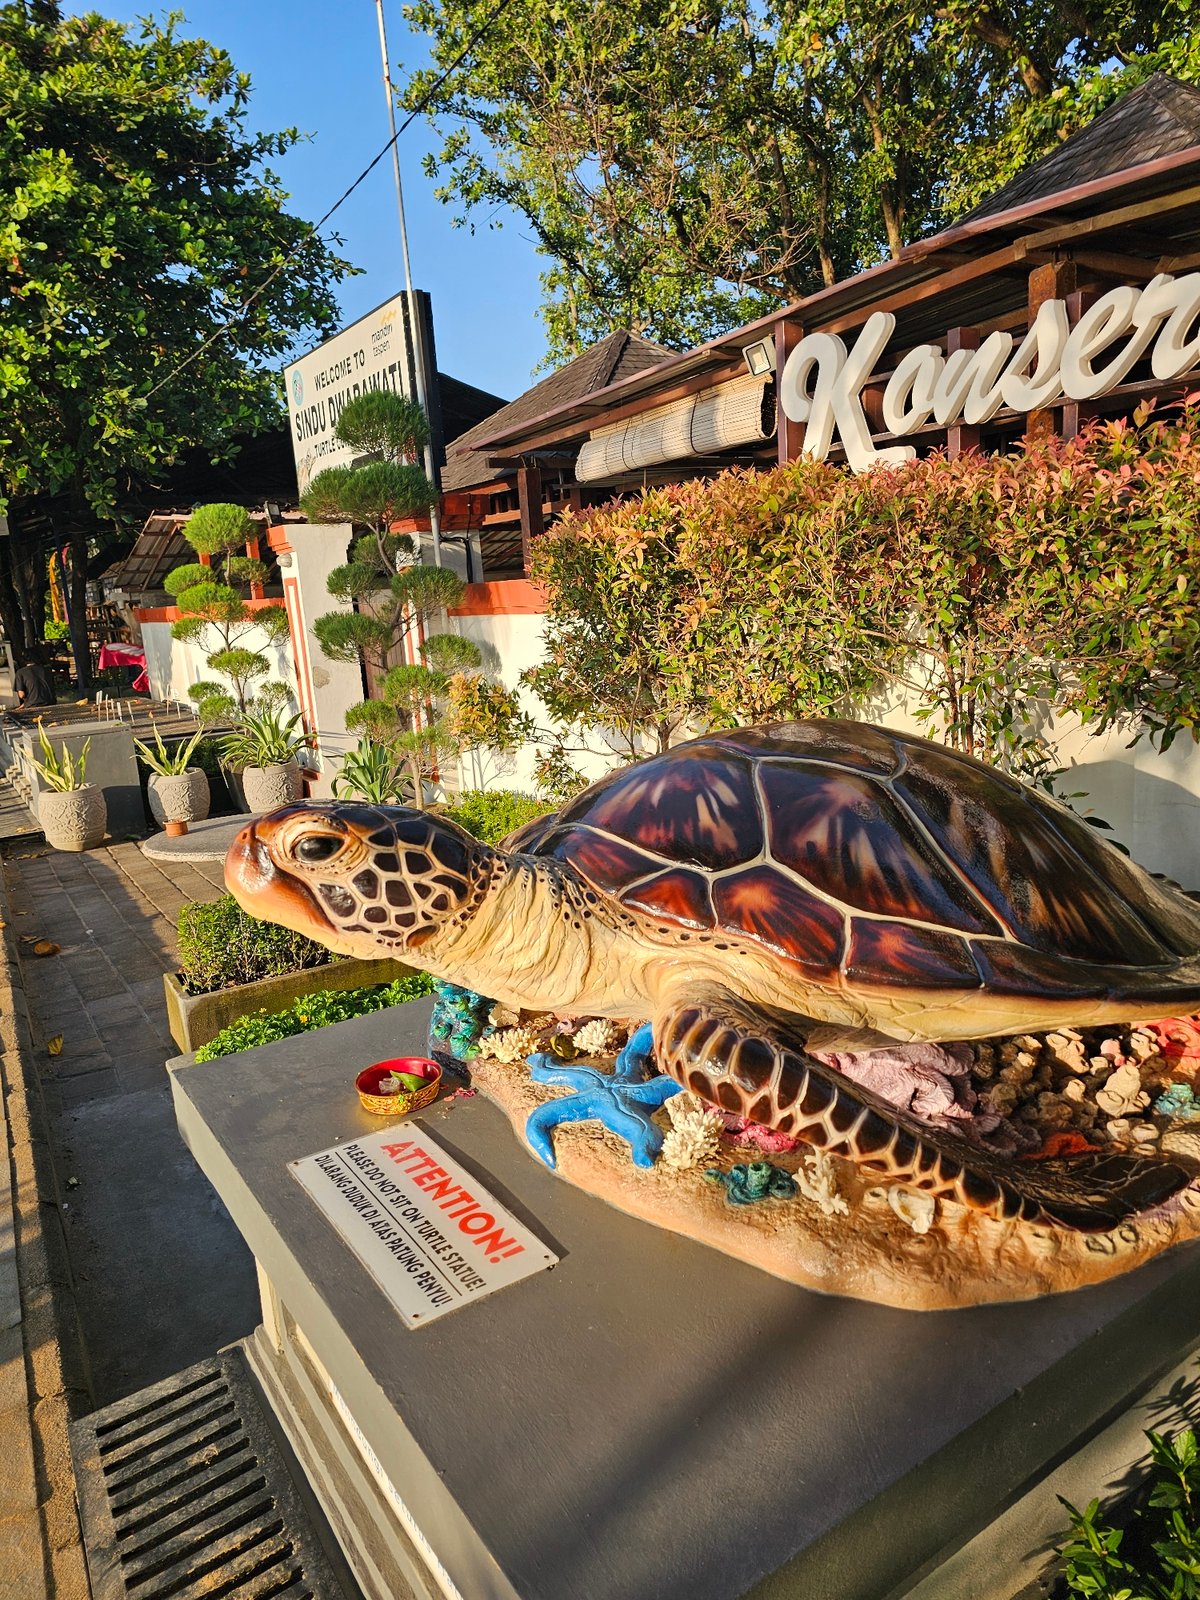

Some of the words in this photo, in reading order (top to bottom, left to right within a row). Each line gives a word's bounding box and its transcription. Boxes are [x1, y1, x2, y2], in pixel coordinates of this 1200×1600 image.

[314, 356, 352, 391] WELCOME
[353, 349, 365, 370] TO
[781, 272, 1200, 475] Konser
[295, 401, 326, 442] SINDU
[314, 437, 336, 458] TURTLE
[314, 1154, 352, 1188] DILARANG
[343, 1144, 375, 1170] PLEASE
[364, 1168, 385, 1181] DO
[374, 1178, 401, 1196] NOT
[341, 1186, 374, 1213] DUDUK
[380, 1141, 525, 1264] ATTENTION!
[390, 1195, 412, 1208] SIT
[361, 1209, 381, 1222] DI
[368, 1219, 398, 1240] ATAS
[401, 1207, 425, 1223] ON
[414, 1219, 453, 1255] TURTLE
[384, 1237, 425, 1273] PATUNG
[441, 1252, 487, 1292] STATUE!
[412, 1271, 453, 1308] PENYU!
